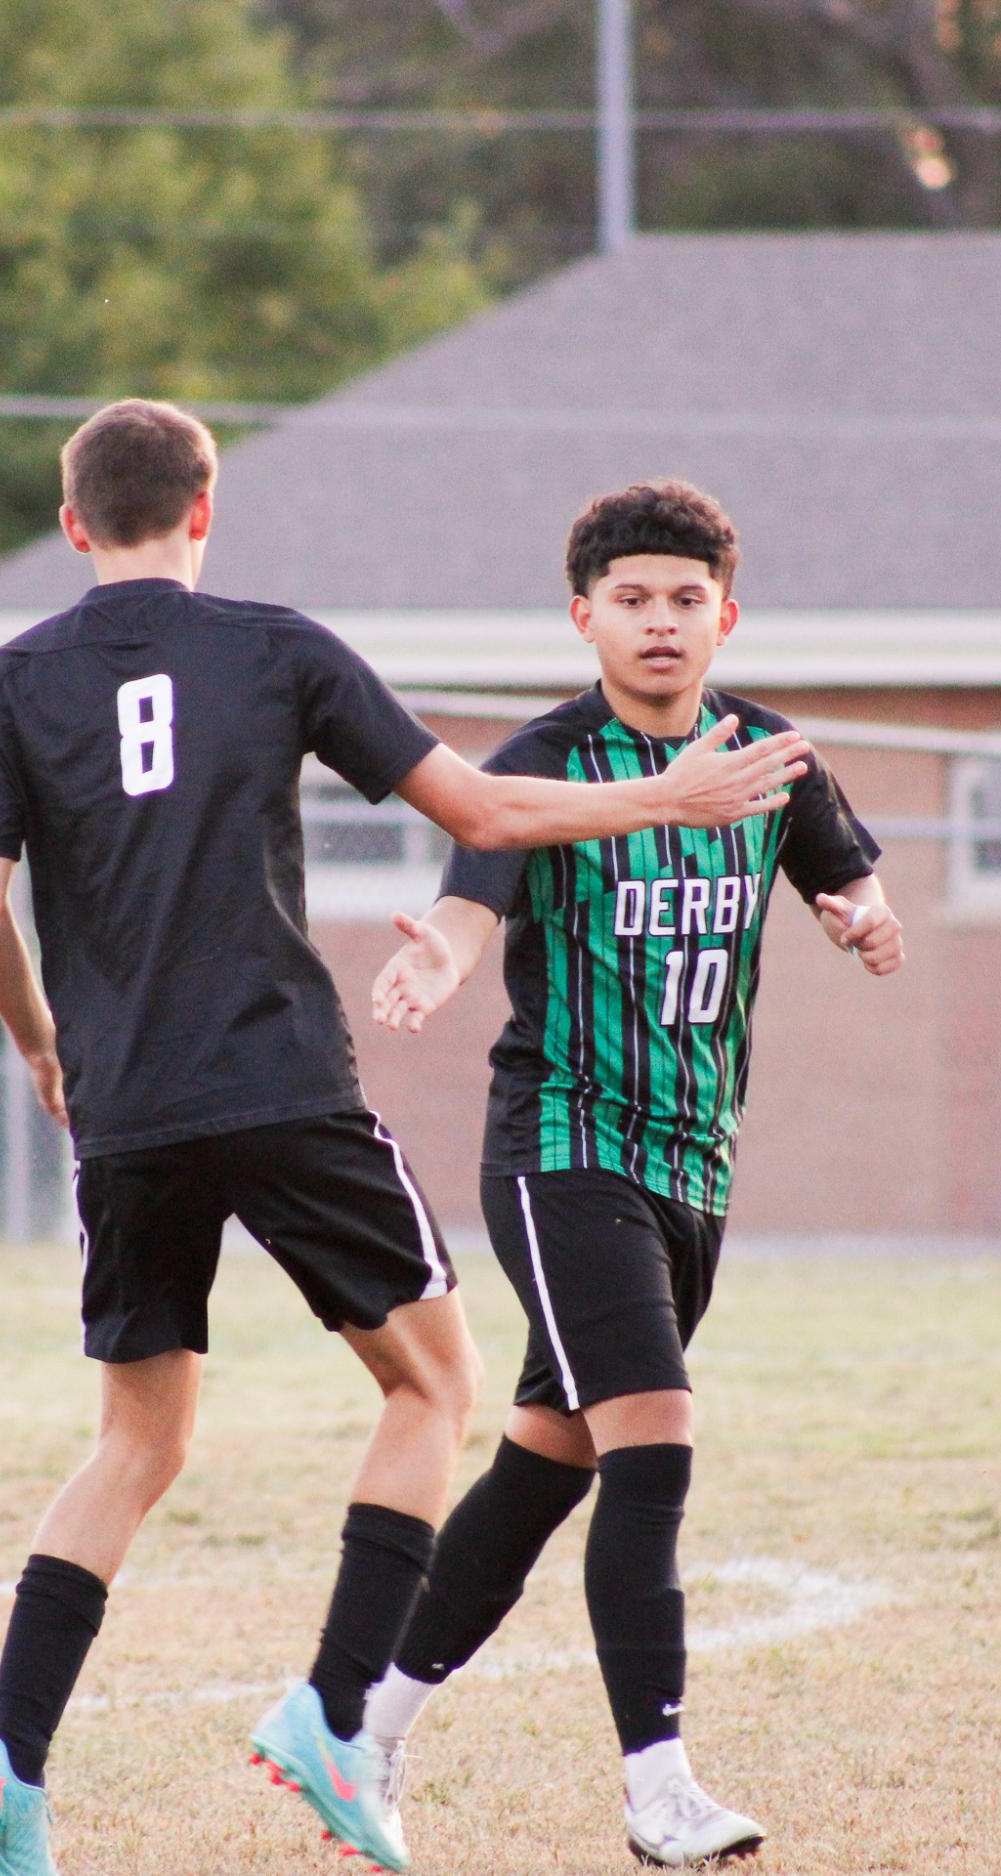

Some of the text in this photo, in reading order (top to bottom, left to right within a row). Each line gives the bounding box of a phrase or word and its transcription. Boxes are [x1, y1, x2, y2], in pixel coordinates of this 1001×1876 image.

[117, 674, 174, 796] 8
[614, 872, 762, 936] DERBY
[660, 949, 729, 1026] 10
